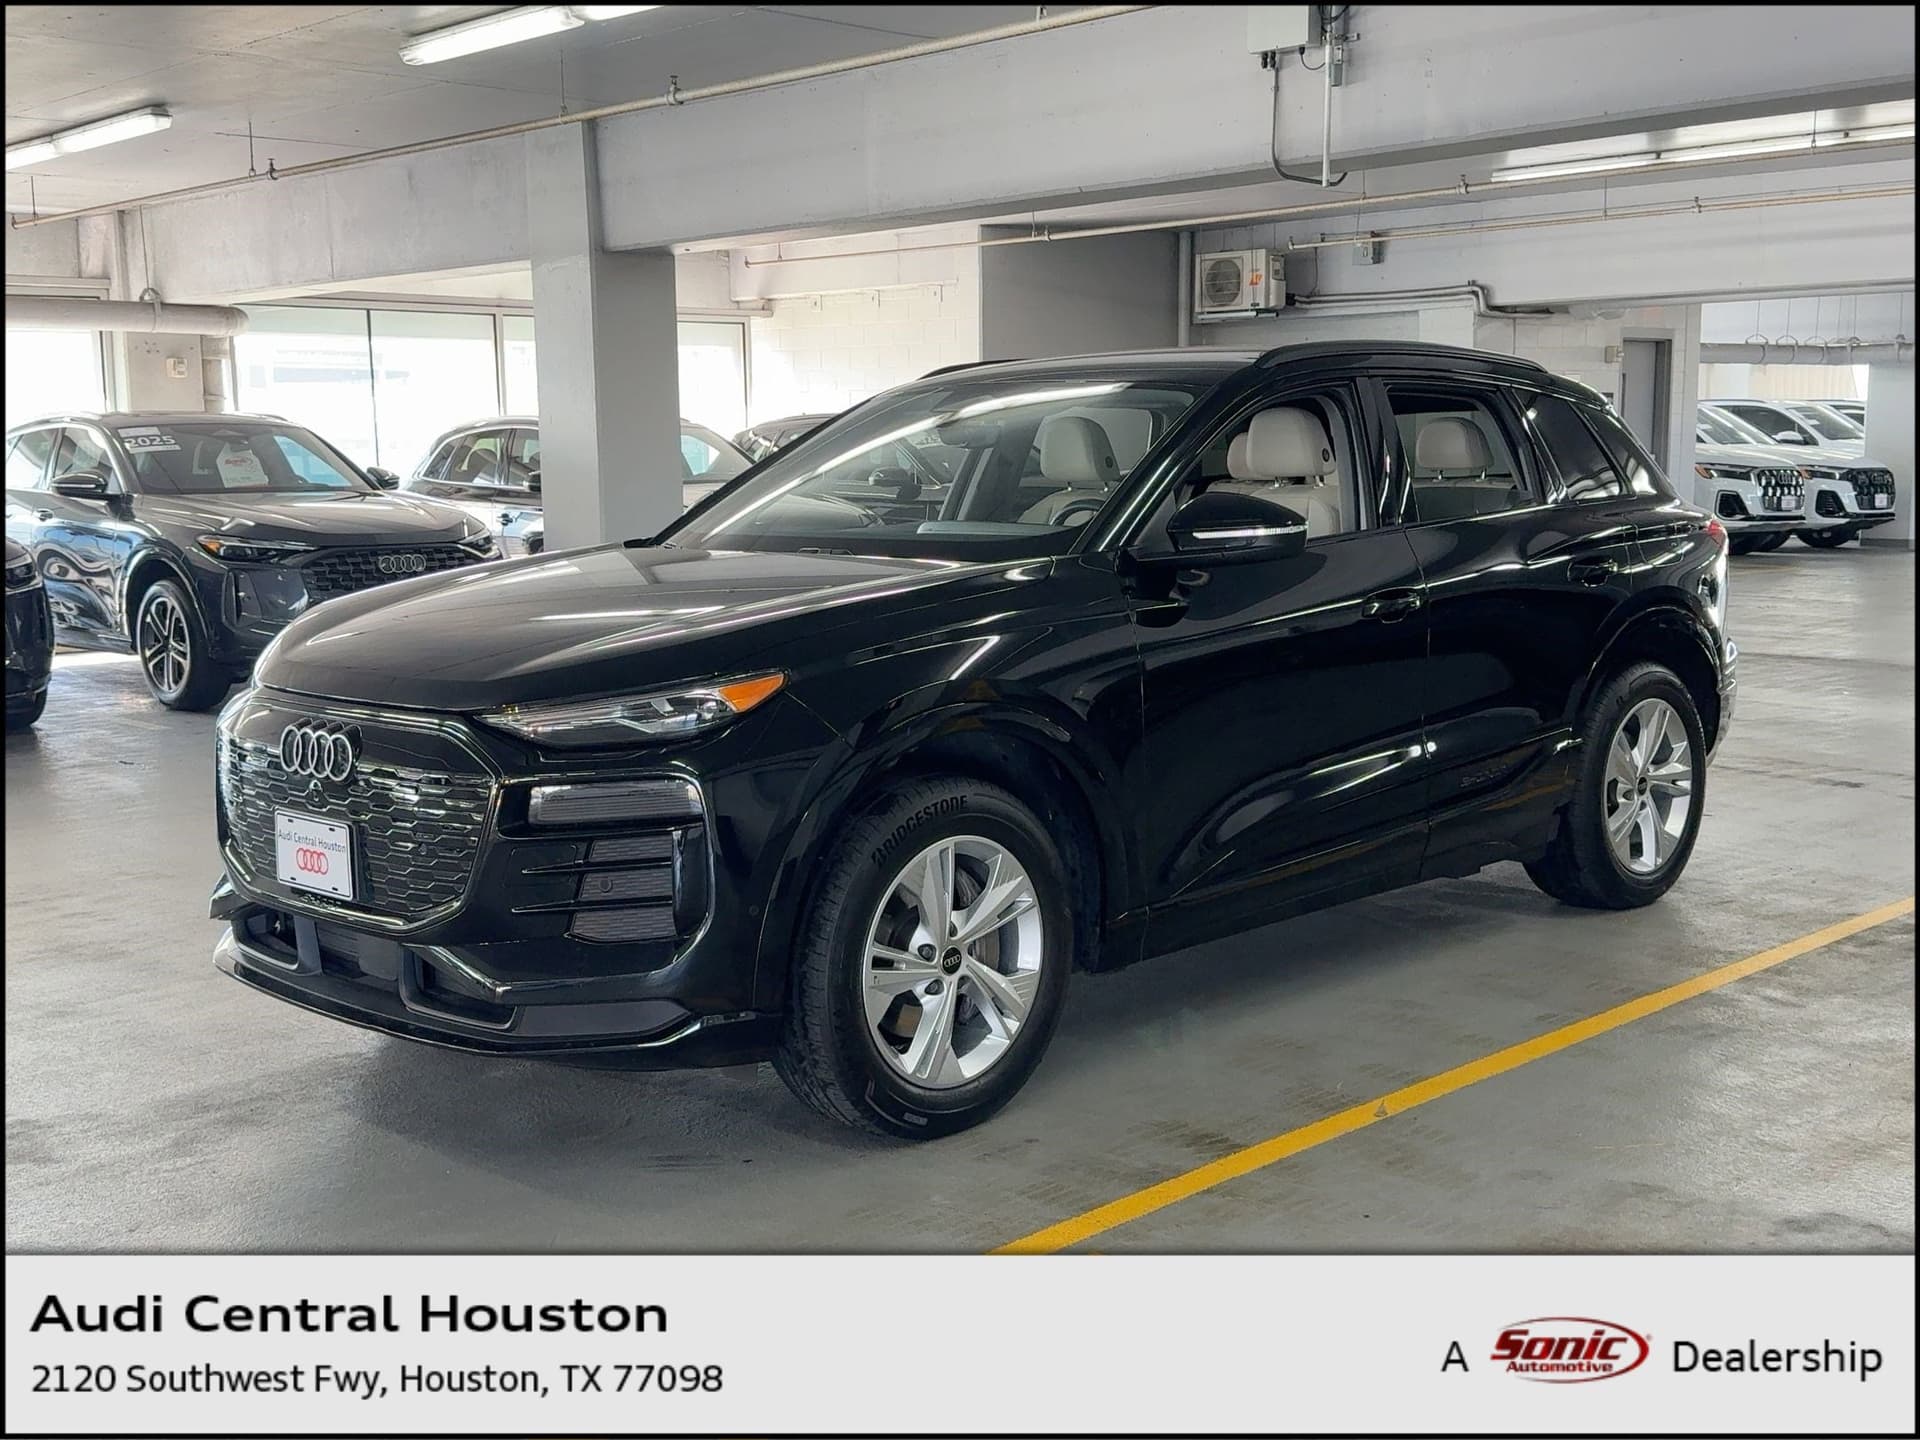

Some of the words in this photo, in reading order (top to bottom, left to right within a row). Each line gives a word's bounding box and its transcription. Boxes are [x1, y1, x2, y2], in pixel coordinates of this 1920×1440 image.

[123, 435, 176, 448] 2025
[278, 829, 292, 841] Audi
[294, 832, 317, 847] Central
[318, 838, 346, 853] Houston
[871, 795, 968, 868] BRIDGESTONE
